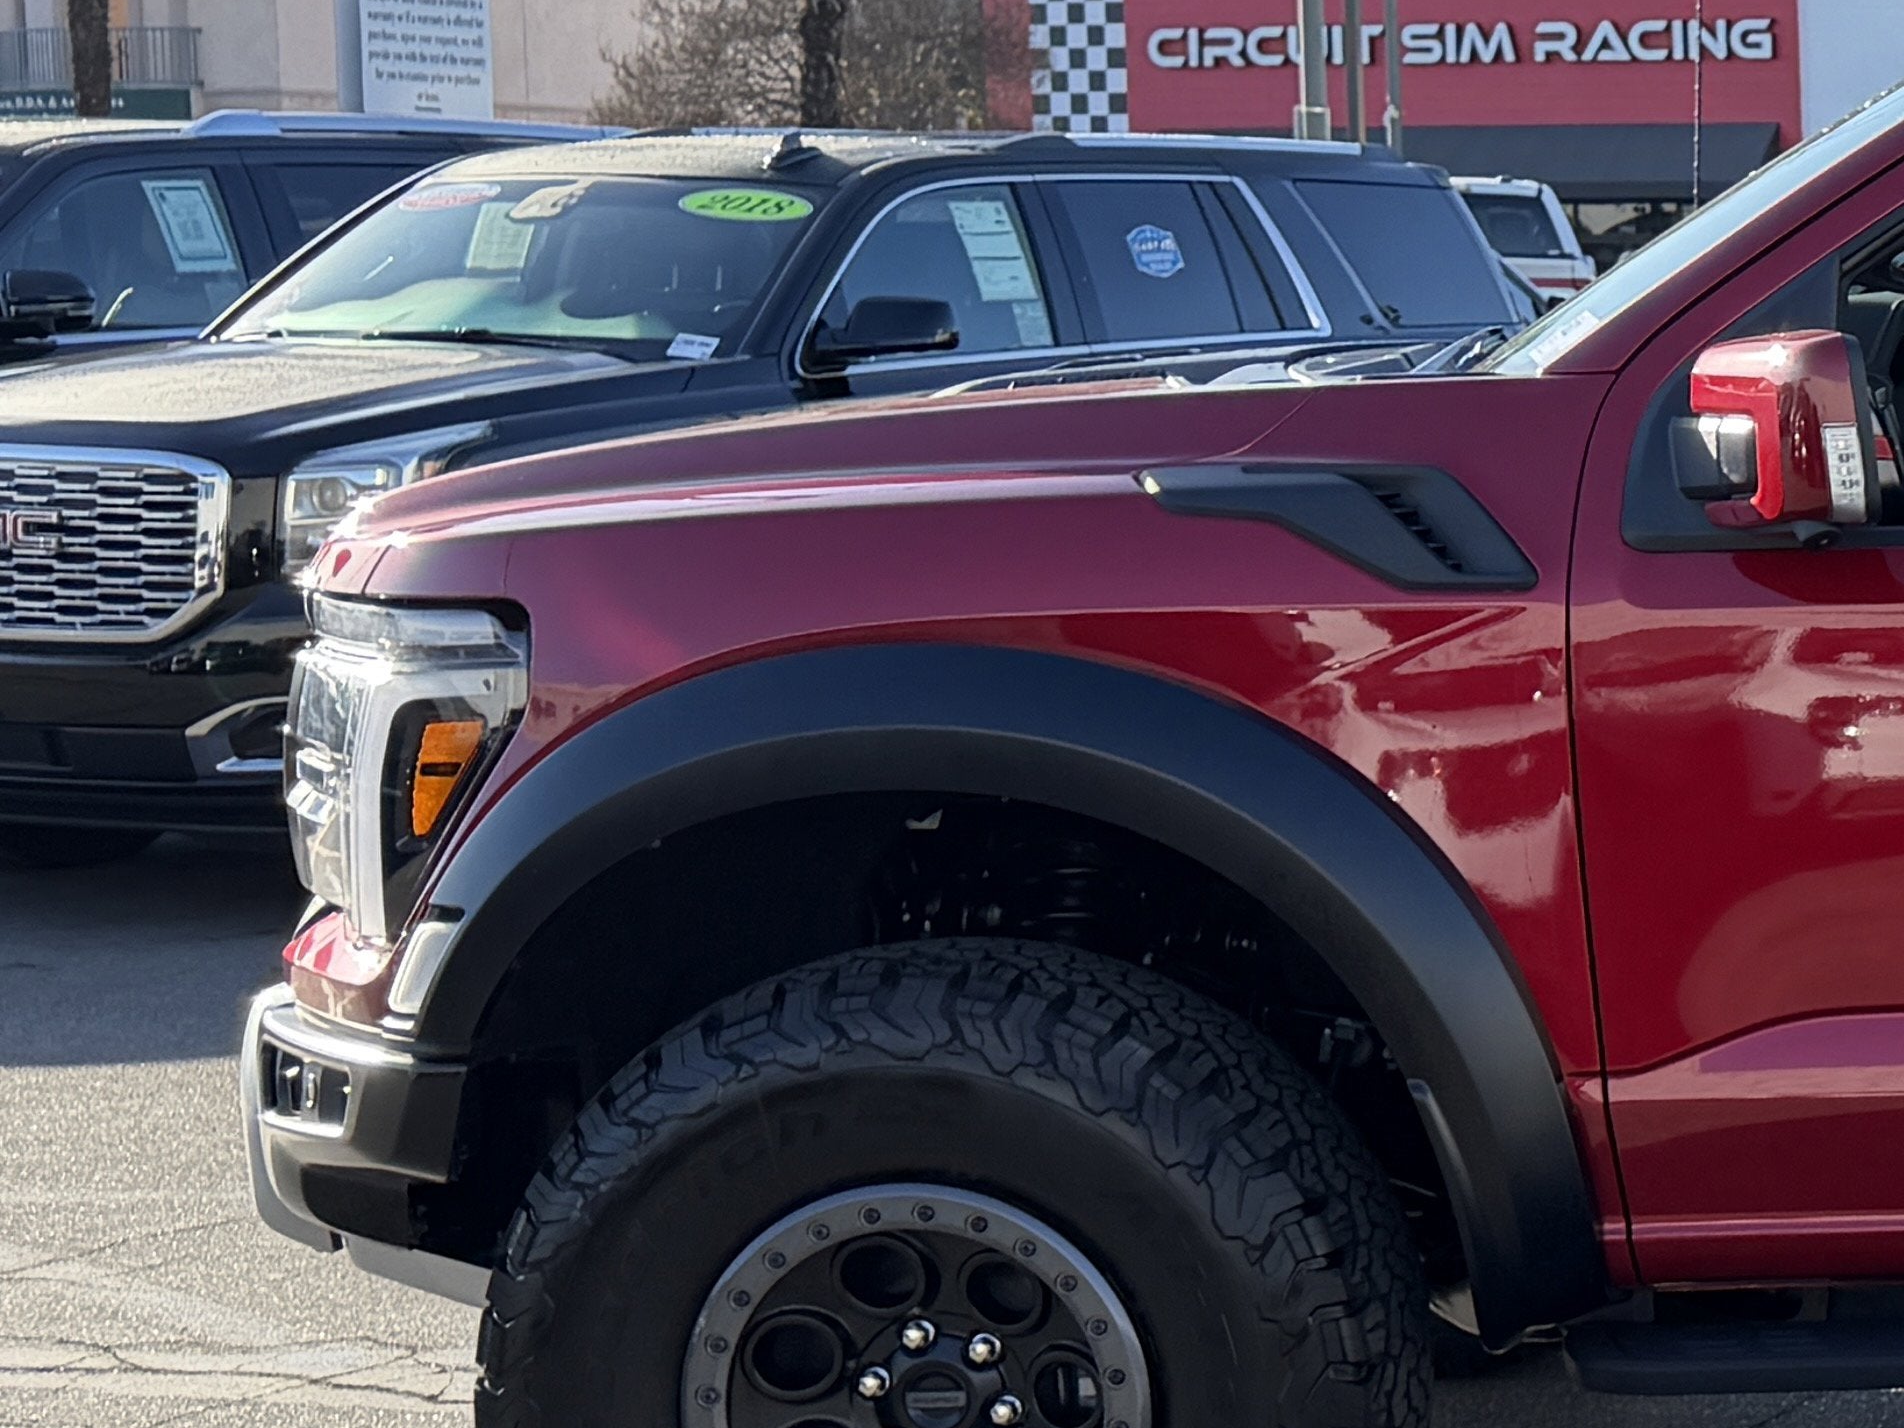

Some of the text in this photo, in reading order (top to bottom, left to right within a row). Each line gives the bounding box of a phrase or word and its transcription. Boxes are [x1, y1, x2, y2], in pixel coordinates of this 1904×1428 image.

[1401, 23, 1517, 65] SIM
[1534, 19, 1773, 62] RACING
[696, 194, 795, 217] 2018
